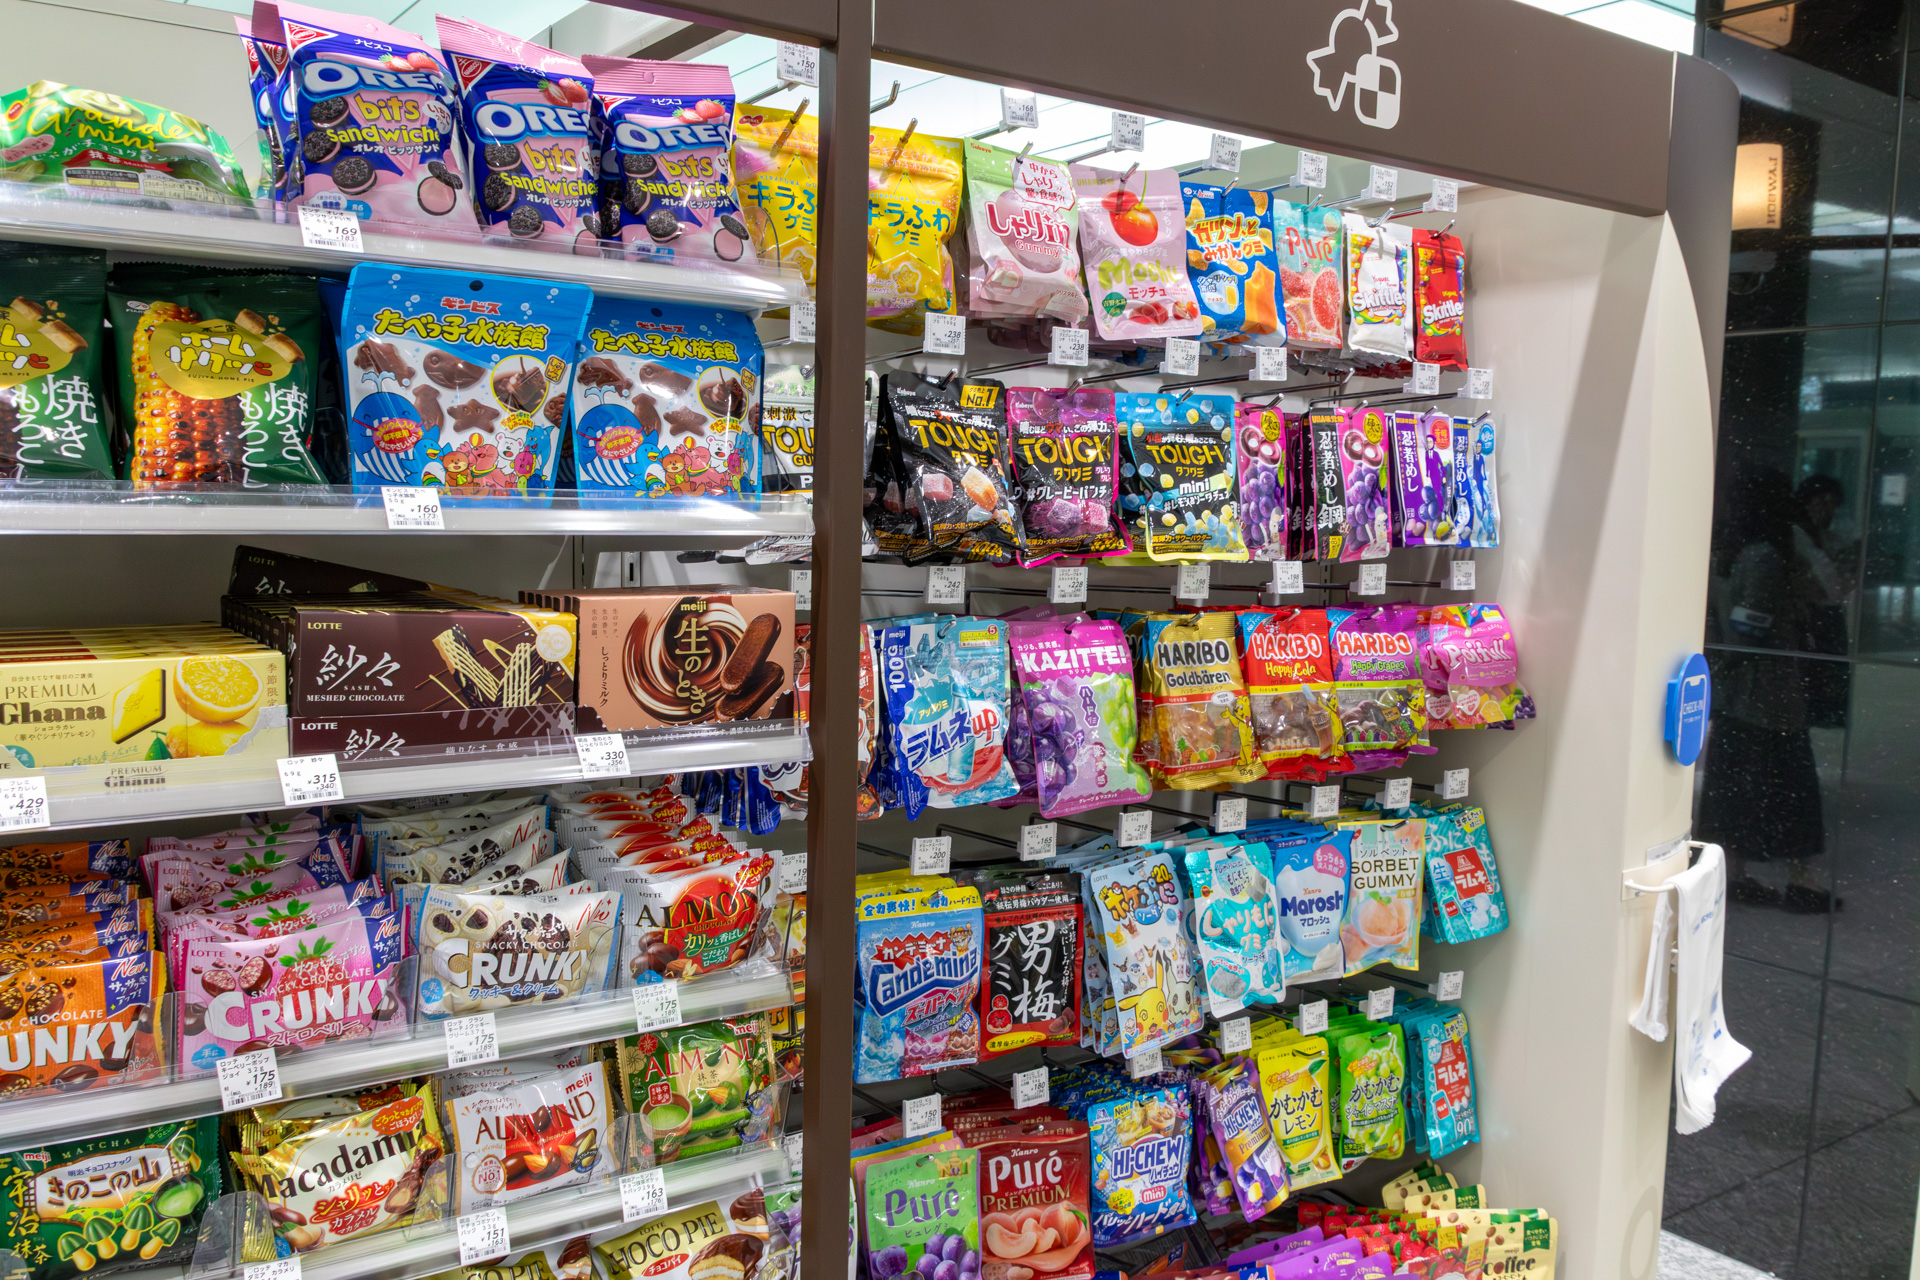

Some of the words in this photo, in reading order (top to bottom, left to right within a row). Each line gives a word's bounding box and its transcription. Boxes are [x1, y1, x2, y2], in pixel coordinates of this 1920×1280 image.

[354, 38, 392, 52] ナビスコ
[354, 93, 421, 121] bits
[27, 100, 193, 140] Grande
[79, 123, 158, 152] mini
[353, 144, 384, 154] オレオ
[388, 145, 440, 155] ビッツサンド
[524, 141, 578, 174] bits
[667, 153, 714, 178] bits
[1029, 162, 1058, 178] 中から
[784, 213, 813, 232] グミ
[892, 229, 920, 246] グミ
[1286, 227, 1333, 263] Puré
[1015, 239, 1061, 258] Gummy
[1128, 287, 1167, 299] モッチュ
[440, 296, 502, 315] ギンビス
[374, 307, 550, 350] たべっ子水族館
[637, 321, 687, 333] ギンビス
[589, 329, 739, 362] たべっ子水族館
[966, 388, 993, 407] No.1
[909, 420, 1001, 455] TOUGH
[1018, 435, 1111, 465] TOUGH
[1146, 445, 1225, 465] TOUGH
[1319, 430, 1339, 504] 忍者めし
[1400, 430, 1419, 492] 忍者めし
[1454, 434, 1467, 496] 忍者めし
[1053, 466, 1092, 482] タフグミ
[1176, 466, 1204, 478] タフグミ
[1180, 478, 1210, 495] mini
[1317, 503, 1344, 530] 鋼
[681, 601, 706, 612] meiji
[307, 622, 343, 630] LOTTE
[889, 630, 906, 639] meiji
[1252, 633, 1322, 660] HARIBO
[1336, 632, 1413, 657] HARIBO
[1020, 645, 1127, 673] KAZITTE!
[1157, 639, 1231, 669] HARIBO
[673, 618, 711, 714] 生のとき
[1351, 659, 1376, 675] Happy
[1377, 660, 1405, 675] Grapes
[11, 673, 94, 682] 自分をもてなす毎日のご褒美
[600, 646, 610, 707] しっとりミルク
[1166, 670, 1231, 688] Goldbären
[5, 682, 97, 699] PREMIUM
[306, 694, 346, 702] MESHED
[348, 694, 405, 702] CHOCOLATE
[0, 701, 107, 726] Ghana
[1683, 700, 1704, 715] CHECK-IN
[301, 722, 338, 730] LOTTE
[111, 765, 162, 774] PREMIUM
[1360, 848, 1408, 858] ソルベット
[1351, 857, 1420, 874] SORBET
[1433, 862, 1450, 880] 生
[1354, 873, 1416, 890] GUMMY
[1455, 870, 1487, 889] ラムネ
[1302, 887, 1321, 895] Kanro
[430, 896, 454, 907] LOTTE
[863, 899, 916, 917] 全力爽快!
[1139, 907, 1159, 919] ソーダ
[1203, 901, 1275, 937] しゃりもに
[1300, 916, 1330, 927] マロッシュ
[911, 920, 935, 928] Kanro
[475, 941, 518, 950] SNACKY
[1240, 933, 1263, 951] グミ
[191, 949, 226, 958] LOTTE
[702, 946, 730, 960] こだわり
[703, 955, 729, 968] ロースト
[1241, 953, 1267, 966] ソーダ味
[1012, 920, 1061, 1024] 男梅
[251, 983, 296, 1000] SNACKY
[300, 967, 372, 987] CHOCOLATE
[869, 947, 978, 1017] Candemina
[468, 984, 560, 1000] クッキー&クリーム
[20, 1009, 103, 1026] CHOCOLATE
[268, 1020, 361, 1047] ストロベリー
[220, 1058, 238, 1067] ロッテ
[245, 1053, 262, 1061] クラン
[222, 1057, 269, 1072] キーベリーポップ
[223, 1071, 240, 1080] ジョイ
[698, 1069, 719, 1081] 抹茶
[1437, 1061, 1467, 1085] ラムネ
[1349, 1073, 1400, 1103] かむかむ
[1114, 1105, 1131, 1117] New
[1270, 1086, 1323, 1119] かむかむ
[1223, 1096, 1261, 1139] HI-CHEW
[1284, 1112, 1317, 1135] レモン
[1057, 1127, 1075, 1136] 白桃
[1238, 1126, 1269, 1155] Premium
[24, 1151, 51, 1162] meiji
[62, 1138, 132, 1160] MATCHA
[1011, 1148, 1039, 1158] Kanro
[1111, 1135, 1183, 1180] HI-CHEW
[67, 1156, 132, 1177] 明治チョコスナック
[988, 1150, 1063, 1193] Puré
[47, 1156, 162, 1206] きのこの山
[327, 1171, 362, 1194] カラメリゼ
[908, 1178, 936, 1188] Kanro
[3, 1167, 40, 1237] 宇治
[983, 1184, 1071, 1212] PREMIUM
[1143, 1187, 1165, 1202] mini
[885, 1182, 960, 1228] Puré
[331, 1207, 377, 1229] カラメル
[461, 1217, 501, 1229] ドチョコポケット
[475, 1212, 495, 1220] アーモン
[681, 1212, 724, 1245] PIE
[253, 1265, 270, 1273] ロッテ
[272, 1267, 294, 1275] カラメリ
[648, 1255, 682, 1275] チョコパイ
[1484, 1255, 1536, 1275] coffee
